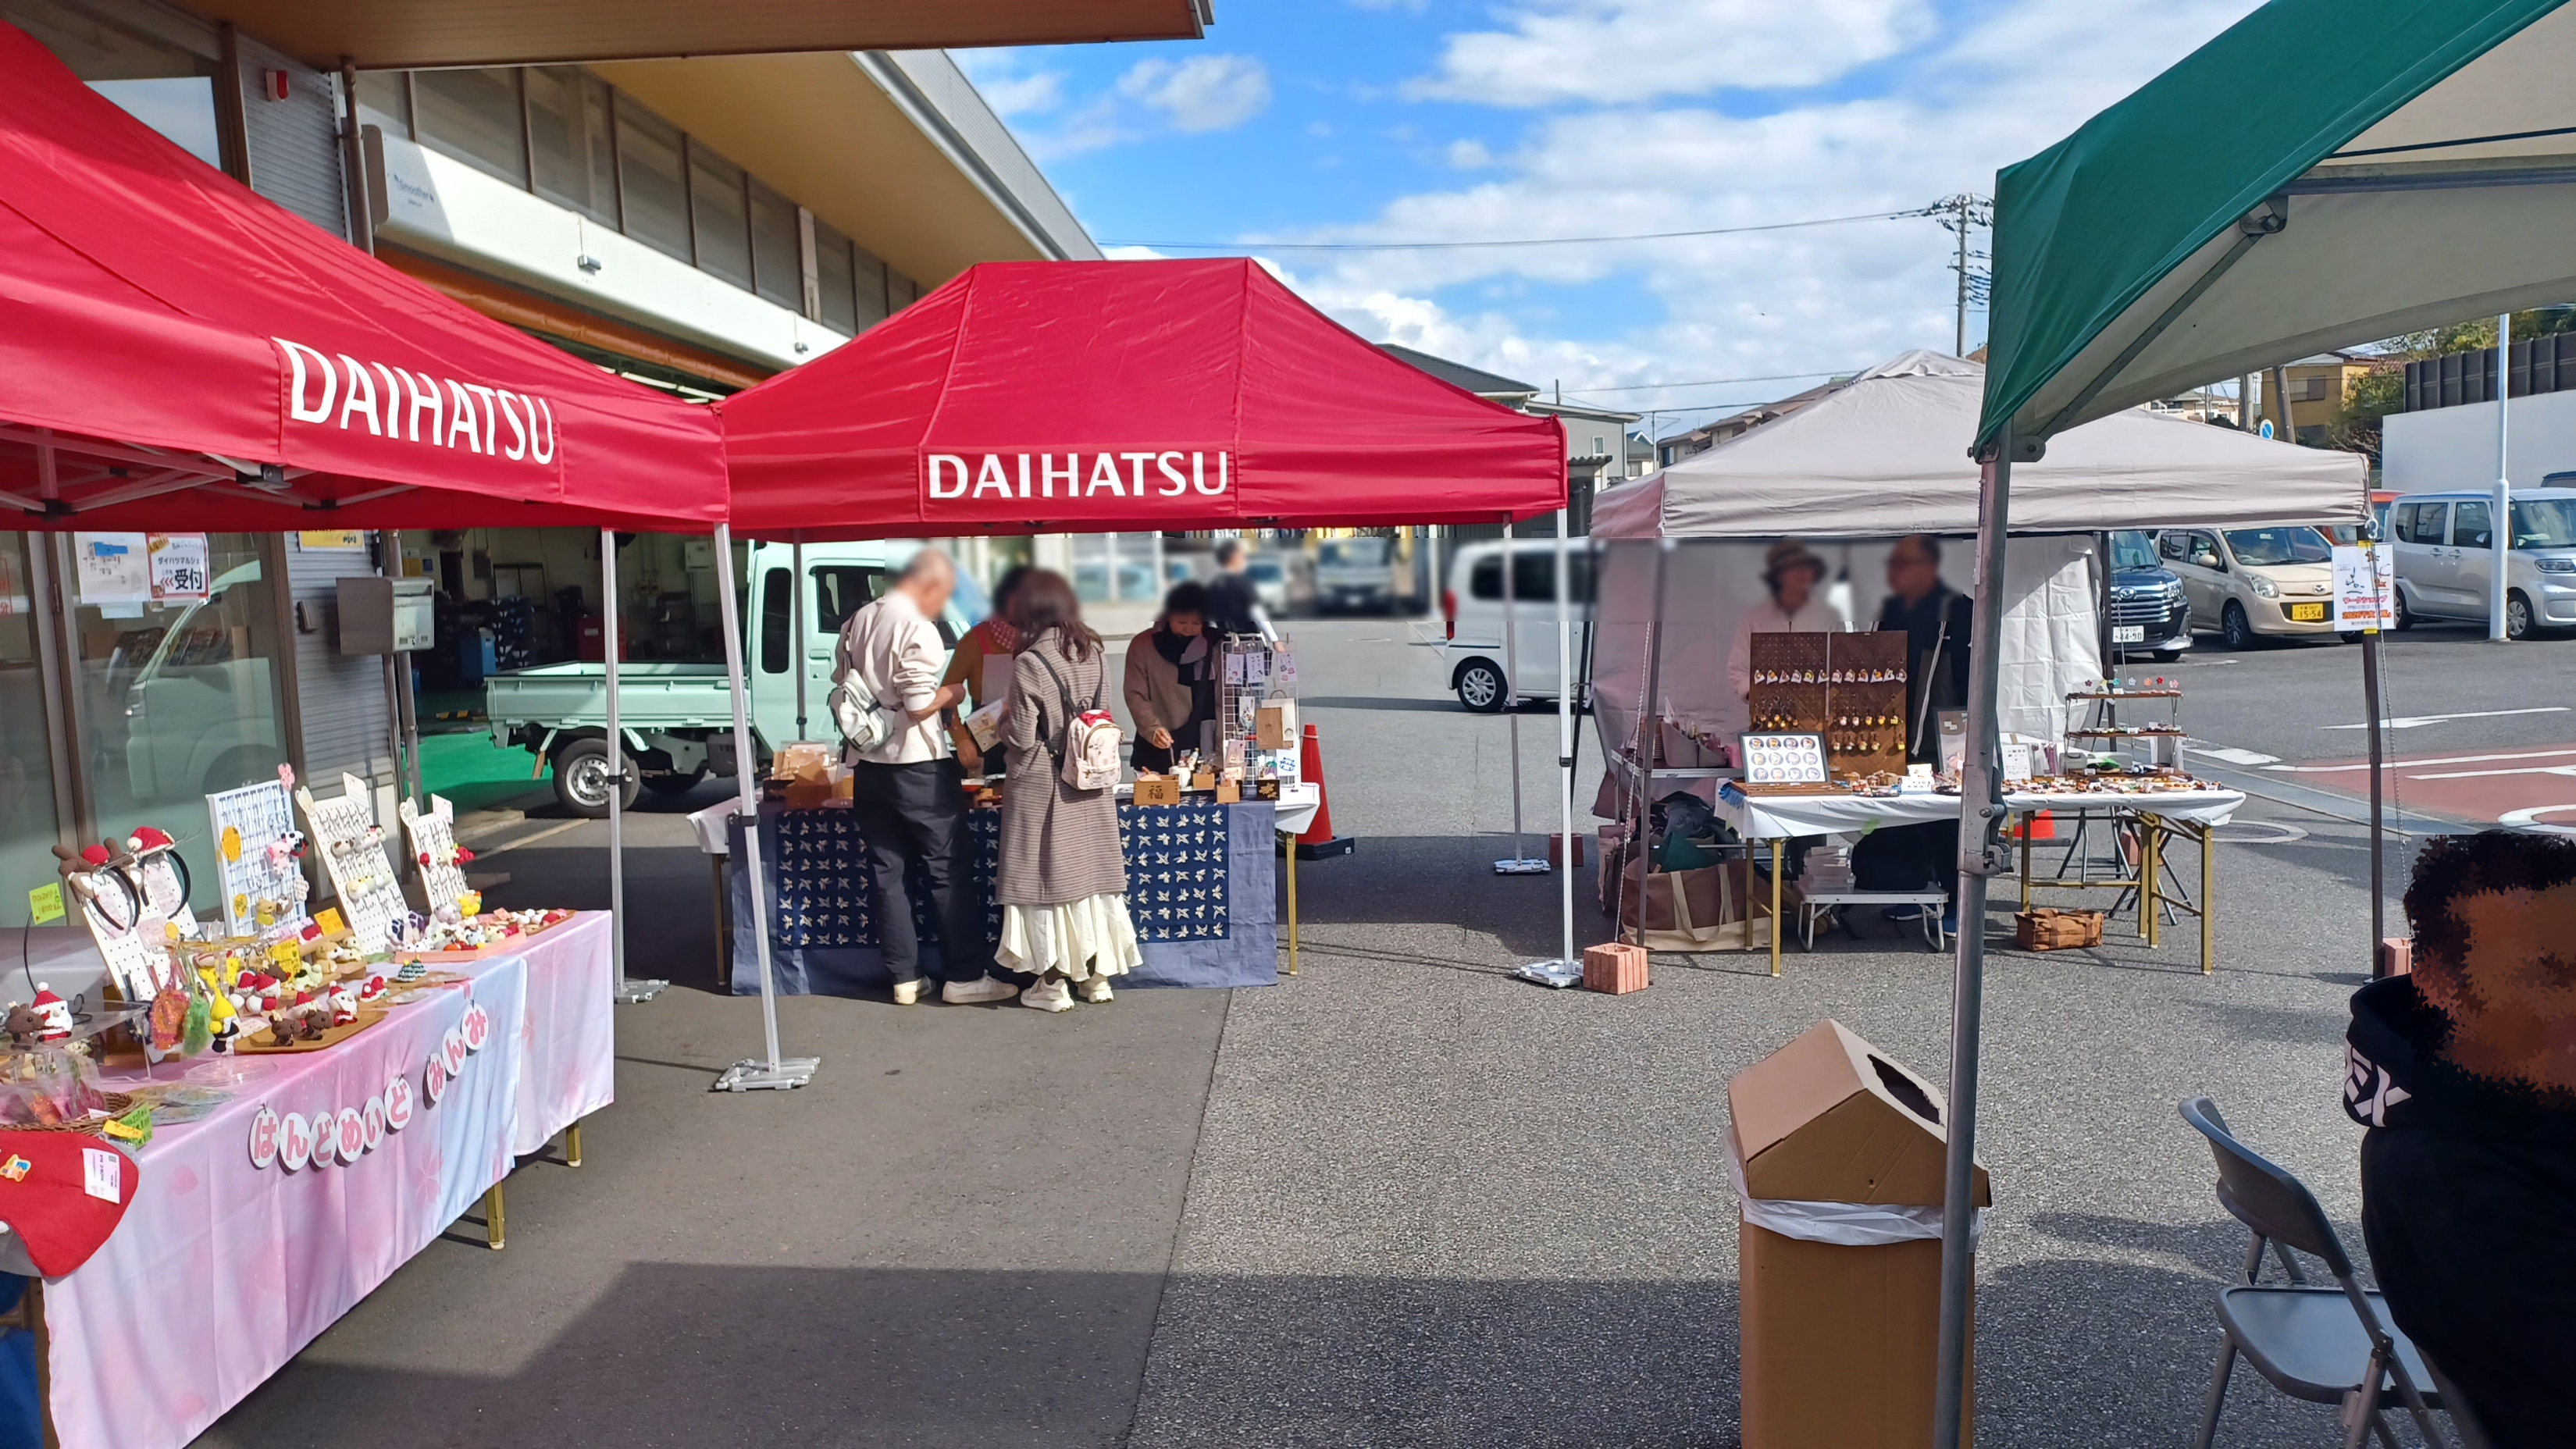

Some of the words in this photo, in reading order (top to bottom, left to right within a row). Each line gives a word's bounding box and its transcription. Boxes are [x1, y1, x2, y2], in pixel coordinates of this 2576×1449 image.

[272, 336, 554, 465] DAIHATSU
[928, 450, 1229, 498] DAIHATSU
[158, 557, 200, 565] ダイハツマルシェ
[174, 568, 202, 590] 受付
[2343, 594, 2387, 604] ワークショプ
[2342, 610, 2391, 619] 2026干支馬」
[1147, 785, 1163, 799] 福
[254, 1082, 408, 1162] はんどめいど
[429, 1009, 486, 1096] みんみ
